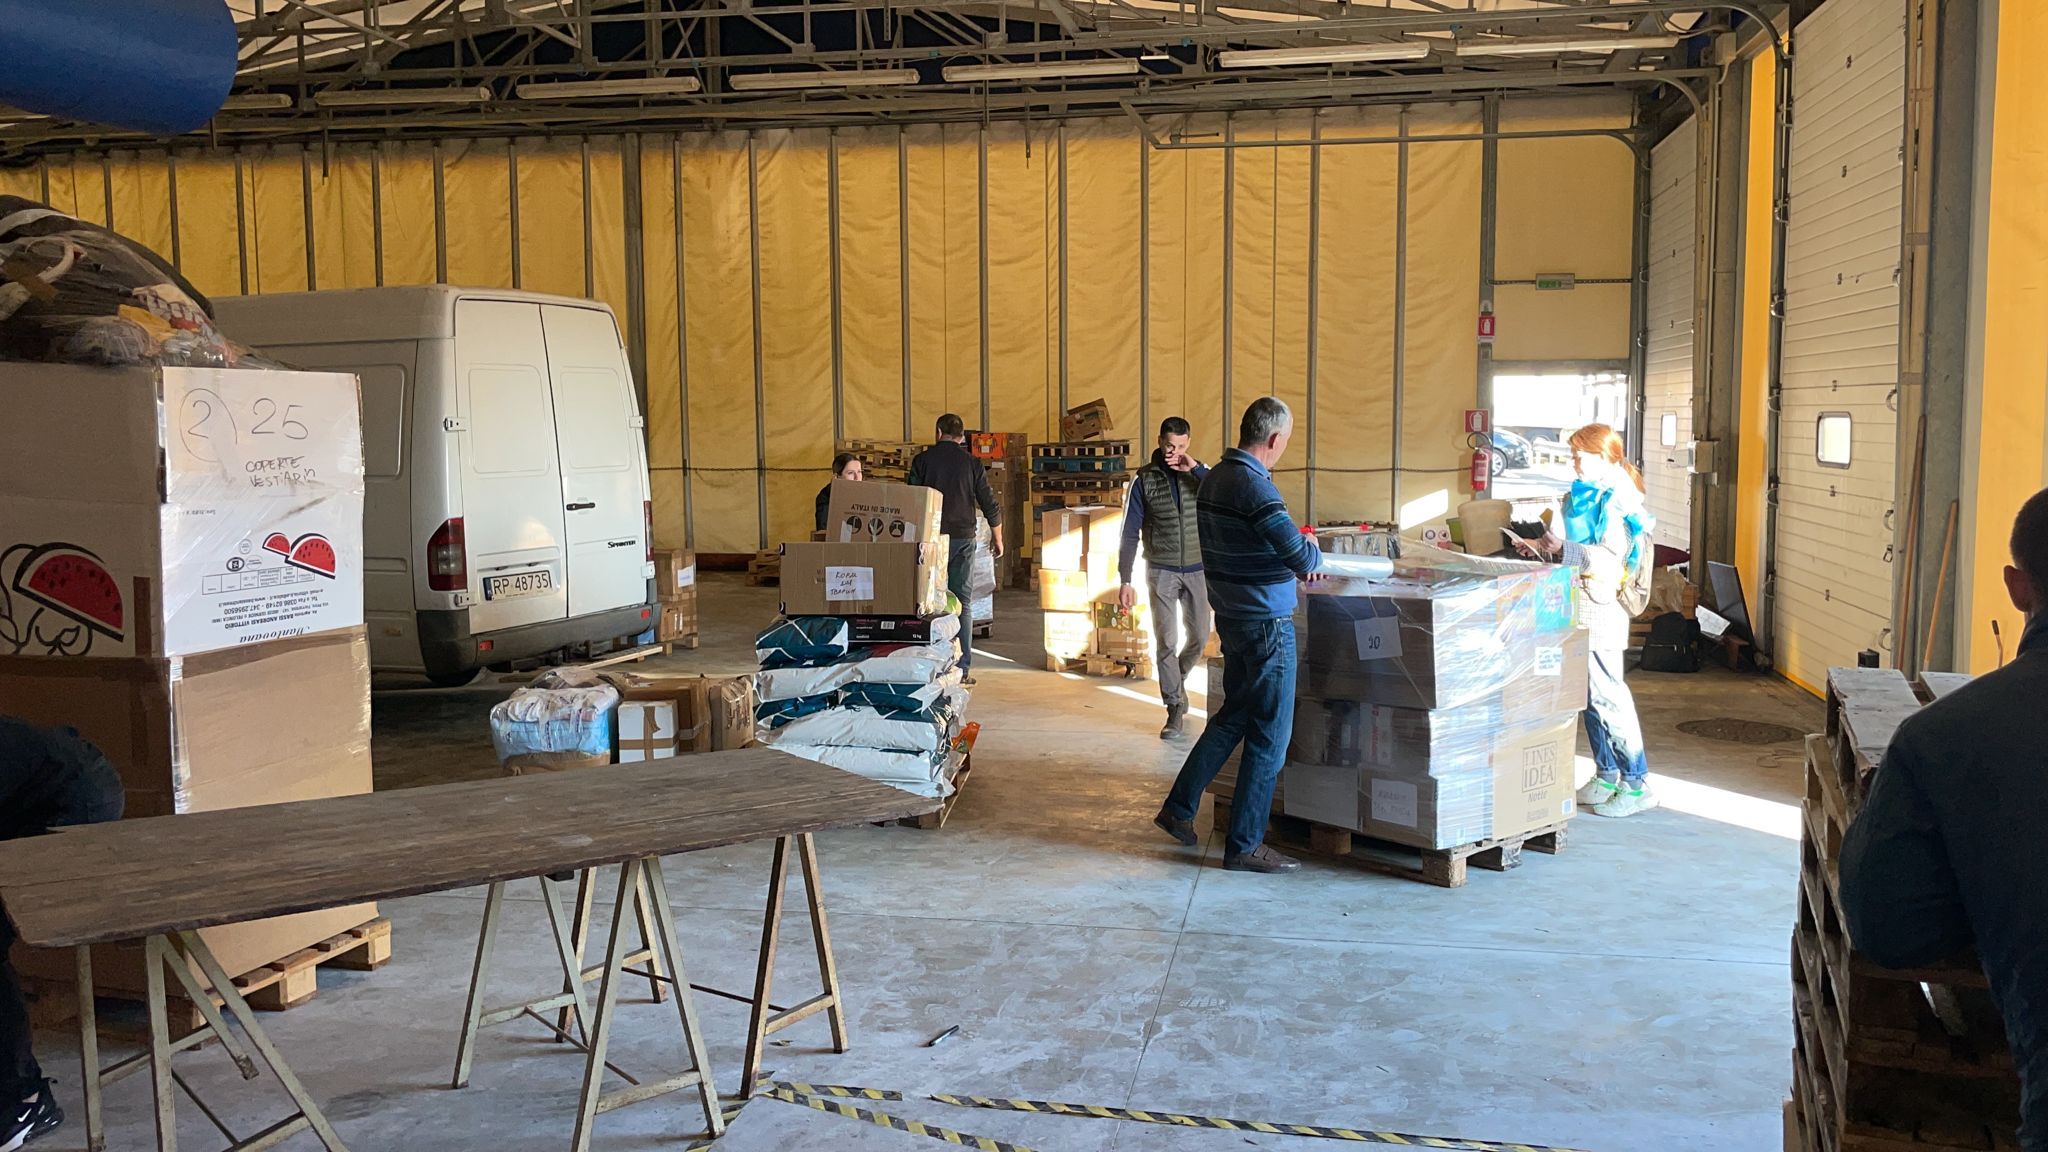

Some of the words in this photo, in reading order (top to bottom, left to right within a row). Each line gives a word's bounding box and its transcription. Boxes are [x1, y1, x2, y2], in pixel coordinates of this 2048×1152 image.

[188, 400, 211, 439] 2
[251, 398, 309, 440] 25
[245, 455, 305, 473] COPERTE
[850, 503, 870, 512] ITALY
[871, 504, 879, 513] IN
[880, 506, 901, 515] MADE
[493, 578, 510, 595] RP
[514, 573, 549, 592] 48735
[1524, 764, 1554, 788] IDEA
